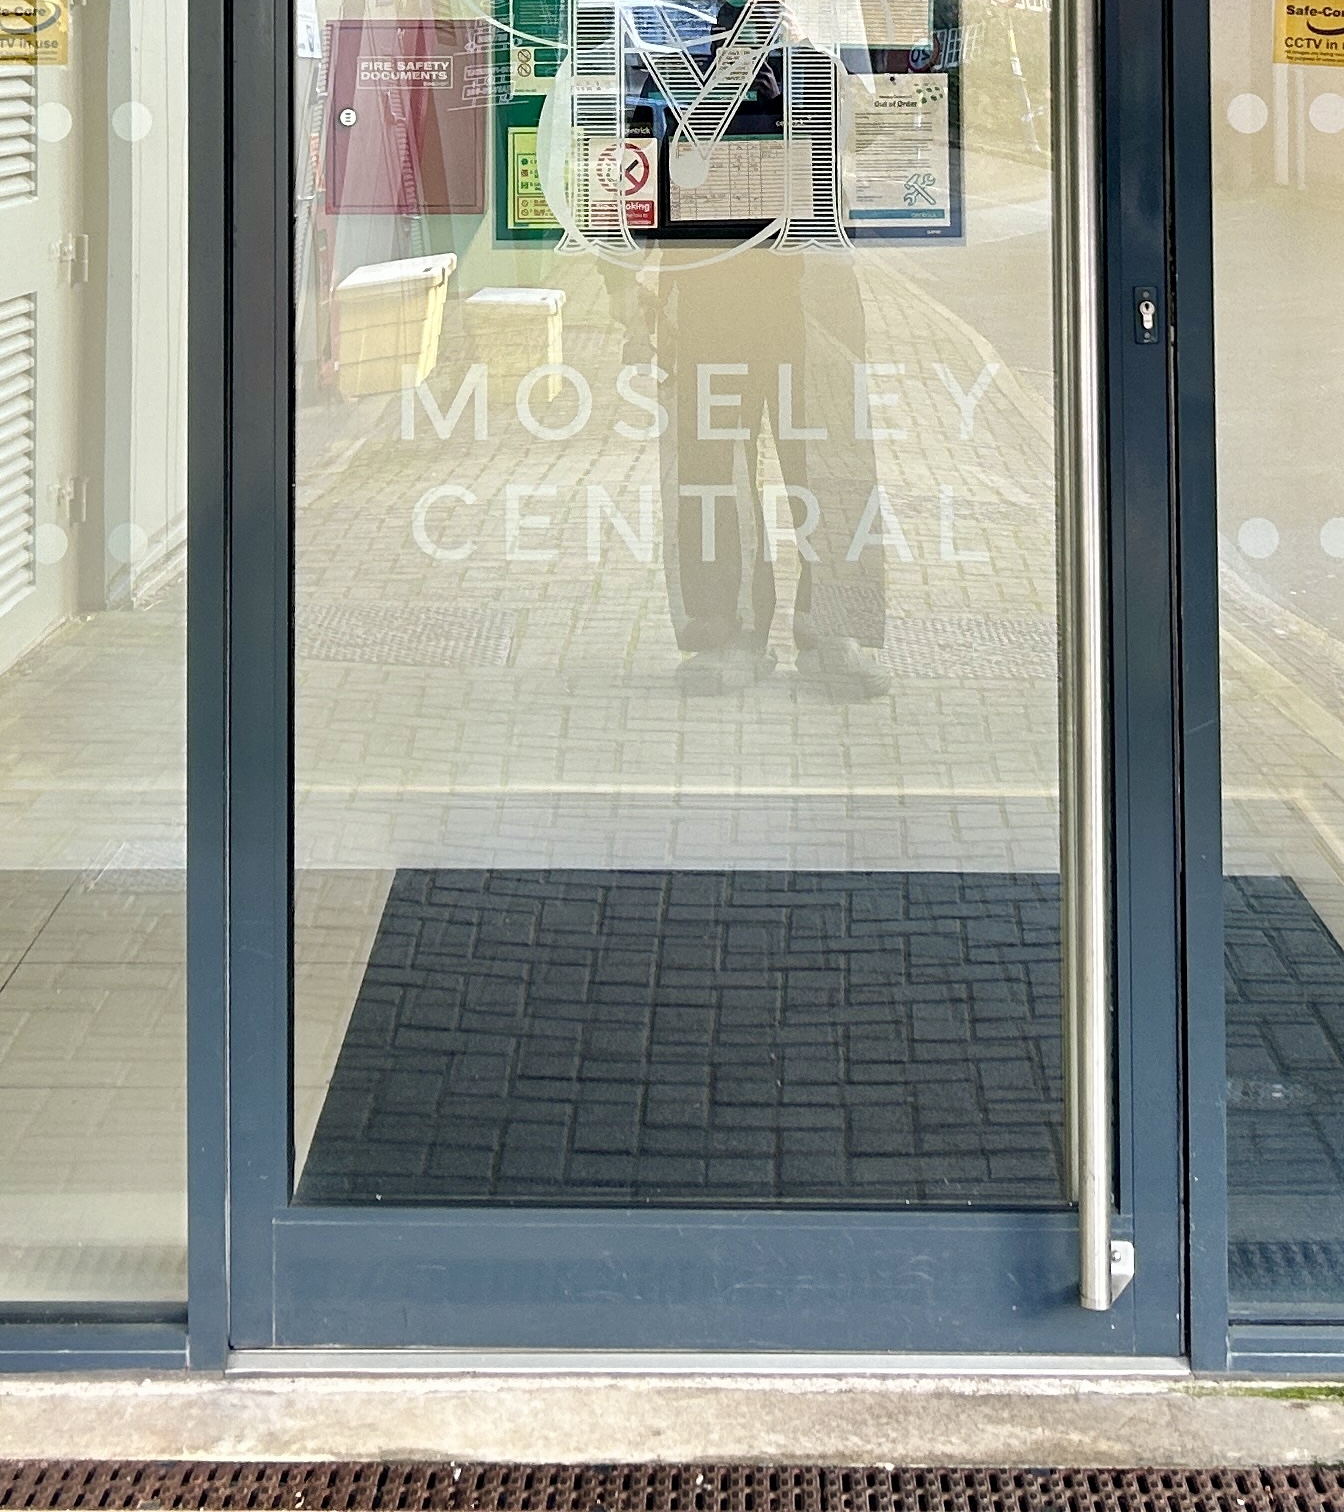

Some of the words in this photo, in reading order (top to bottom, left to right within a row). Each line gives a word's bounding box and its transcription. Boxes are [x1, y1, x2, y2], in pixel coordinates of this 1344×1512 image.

[1284, 36, 1322, 49] CCTV
[1326, 39, 1338, 49] in
[361, 61, 394, 71] FIRE
[397, 61, 450, 71] SAFETY
[361, 71, 448, 80] DOCUMENTS
[625, 202, 650, 212] oking
[401, 363, 999, 442] MOSELEY
[412, 484, 991, 563] CENTRAL
